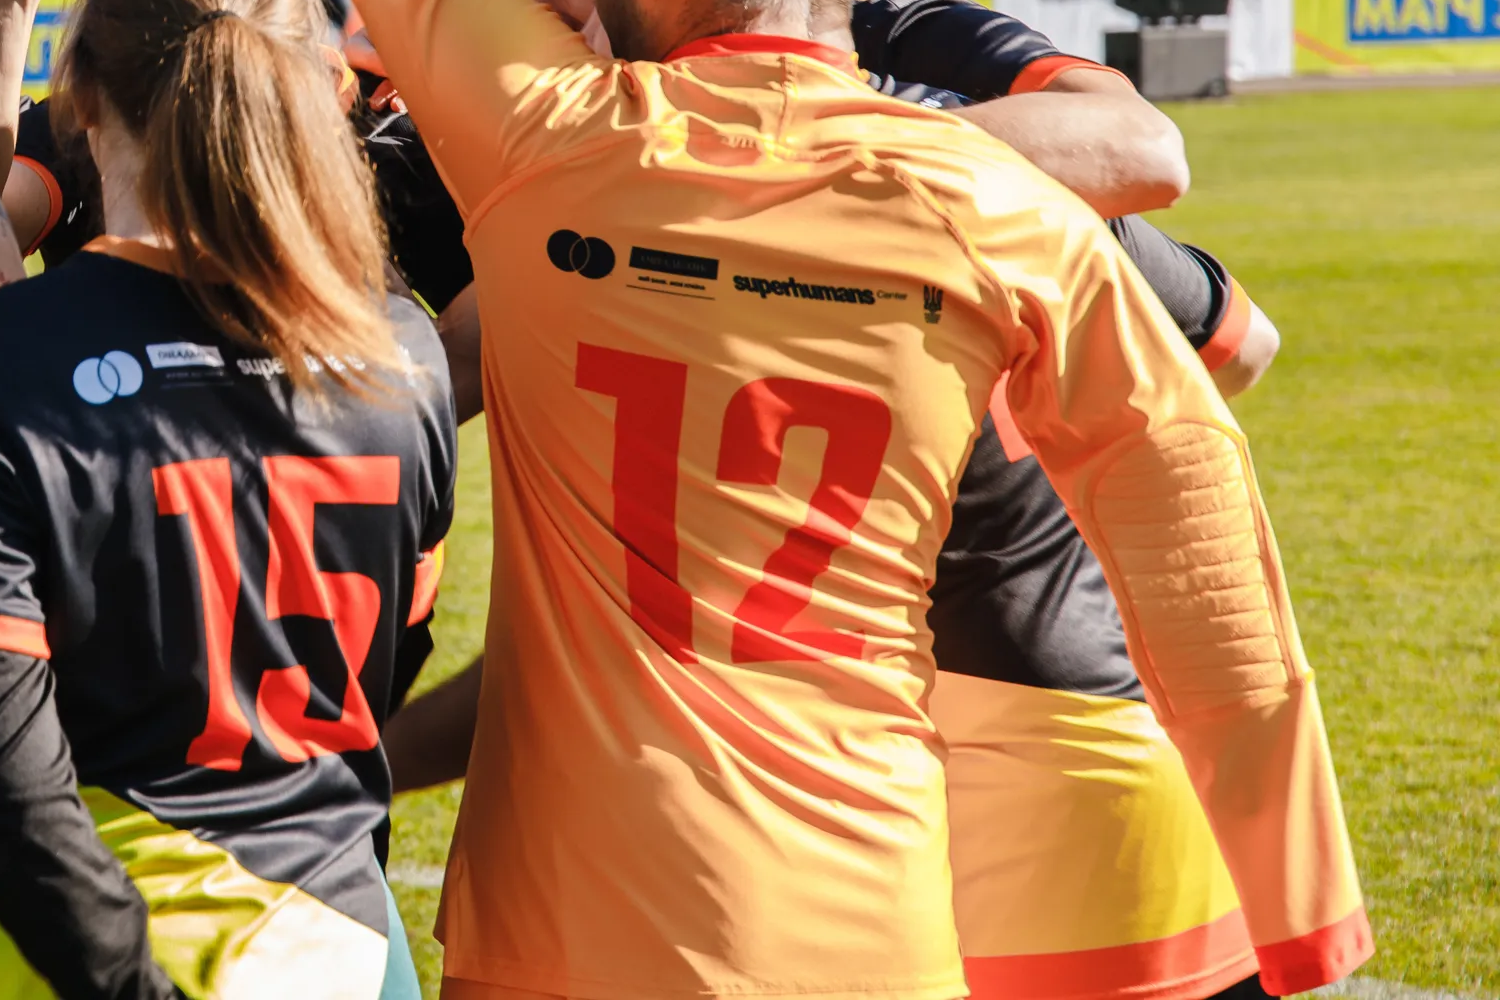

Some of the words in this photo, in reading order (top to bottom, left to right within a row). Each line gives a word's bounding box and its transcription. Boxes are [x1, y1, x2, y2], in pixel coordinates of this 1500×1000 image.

[733, 274, 876, 306] superhumans
[151, 455, 400, 772] 15
[575, 341, 892, 665] 12
